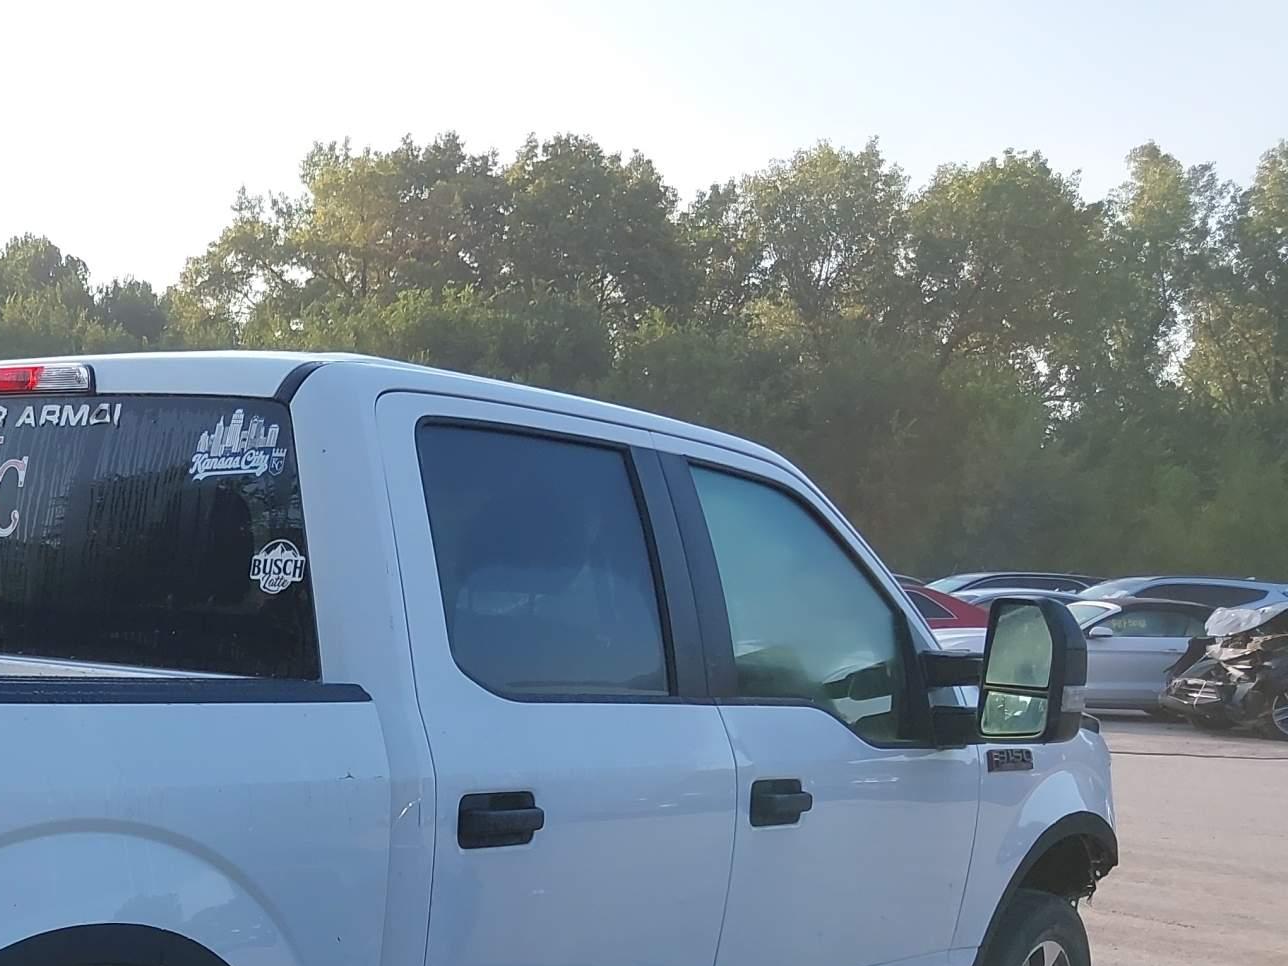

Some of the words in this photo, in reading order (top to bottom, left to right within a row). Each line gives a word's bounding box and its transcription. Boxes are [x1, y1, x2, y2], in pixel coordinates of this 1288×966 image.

[189, 453, 242, 474] Kansas
[241, 449, 270, 476] City
[251, 558, 305, 578] BUSCH
[262, 574, 290, 592] Latte
